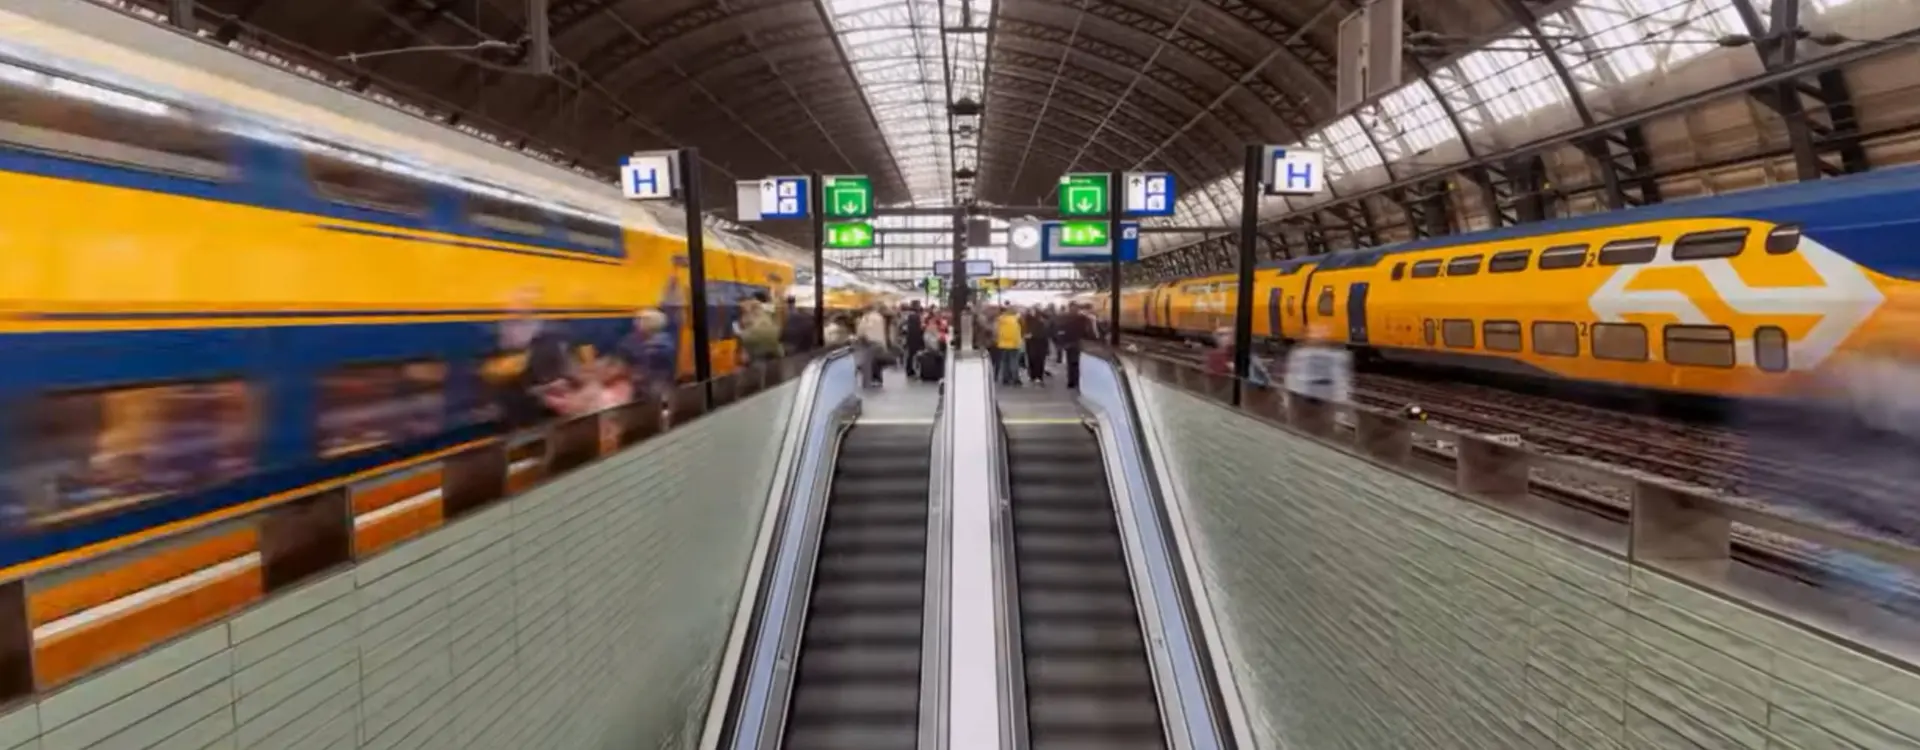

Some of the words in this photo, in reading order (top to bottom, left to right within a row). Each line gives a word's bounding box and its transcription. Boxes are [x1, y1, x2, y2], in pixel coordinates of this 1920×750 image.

[634, 168, 657, 194] H
[1288, 163, 1311, 188] H
[1588, 253, 1596, 267] 2
[1580, 323, 1588, 337] 2
